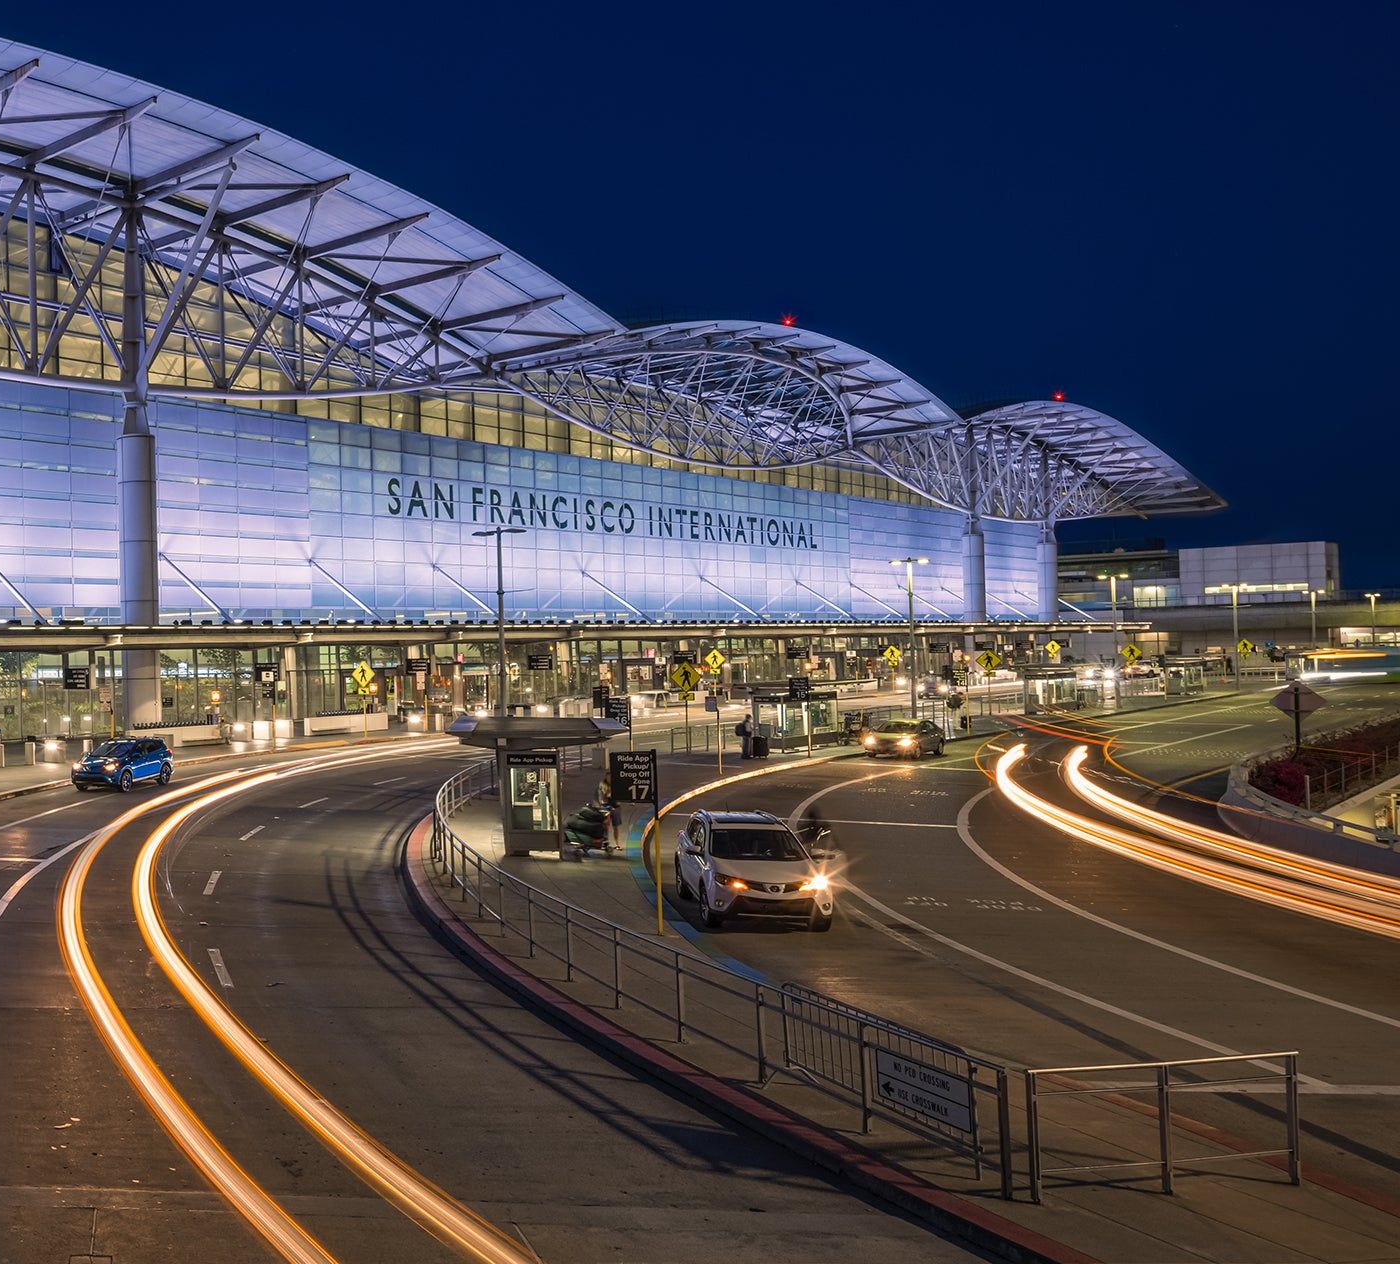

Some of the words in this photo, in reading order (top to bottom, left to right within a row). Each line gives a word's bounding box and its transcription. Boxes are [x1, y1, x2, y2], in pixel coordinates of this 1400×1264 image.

[387, 478, 455, 519] SAN
[472, 487, 635, 534] FRANCISCO
[648, 506, 818, 549] INTERNATIONAL
[796, 691, 806, 699] 15
[615, 716, 628, 725] 16
[635, 755, 650, 763] App
[620, 771, 638, 779] Drop
[628, 785, 650, 800] 17
[893, 1061, 902, 1073] NO
[904, 1065, 917, 1079] PED
[919, 1071, 951, 1092] CROSSING
[897, 1088, 909, 1102] USE
[912, 1094, 949, 1117] CROSSWALK
